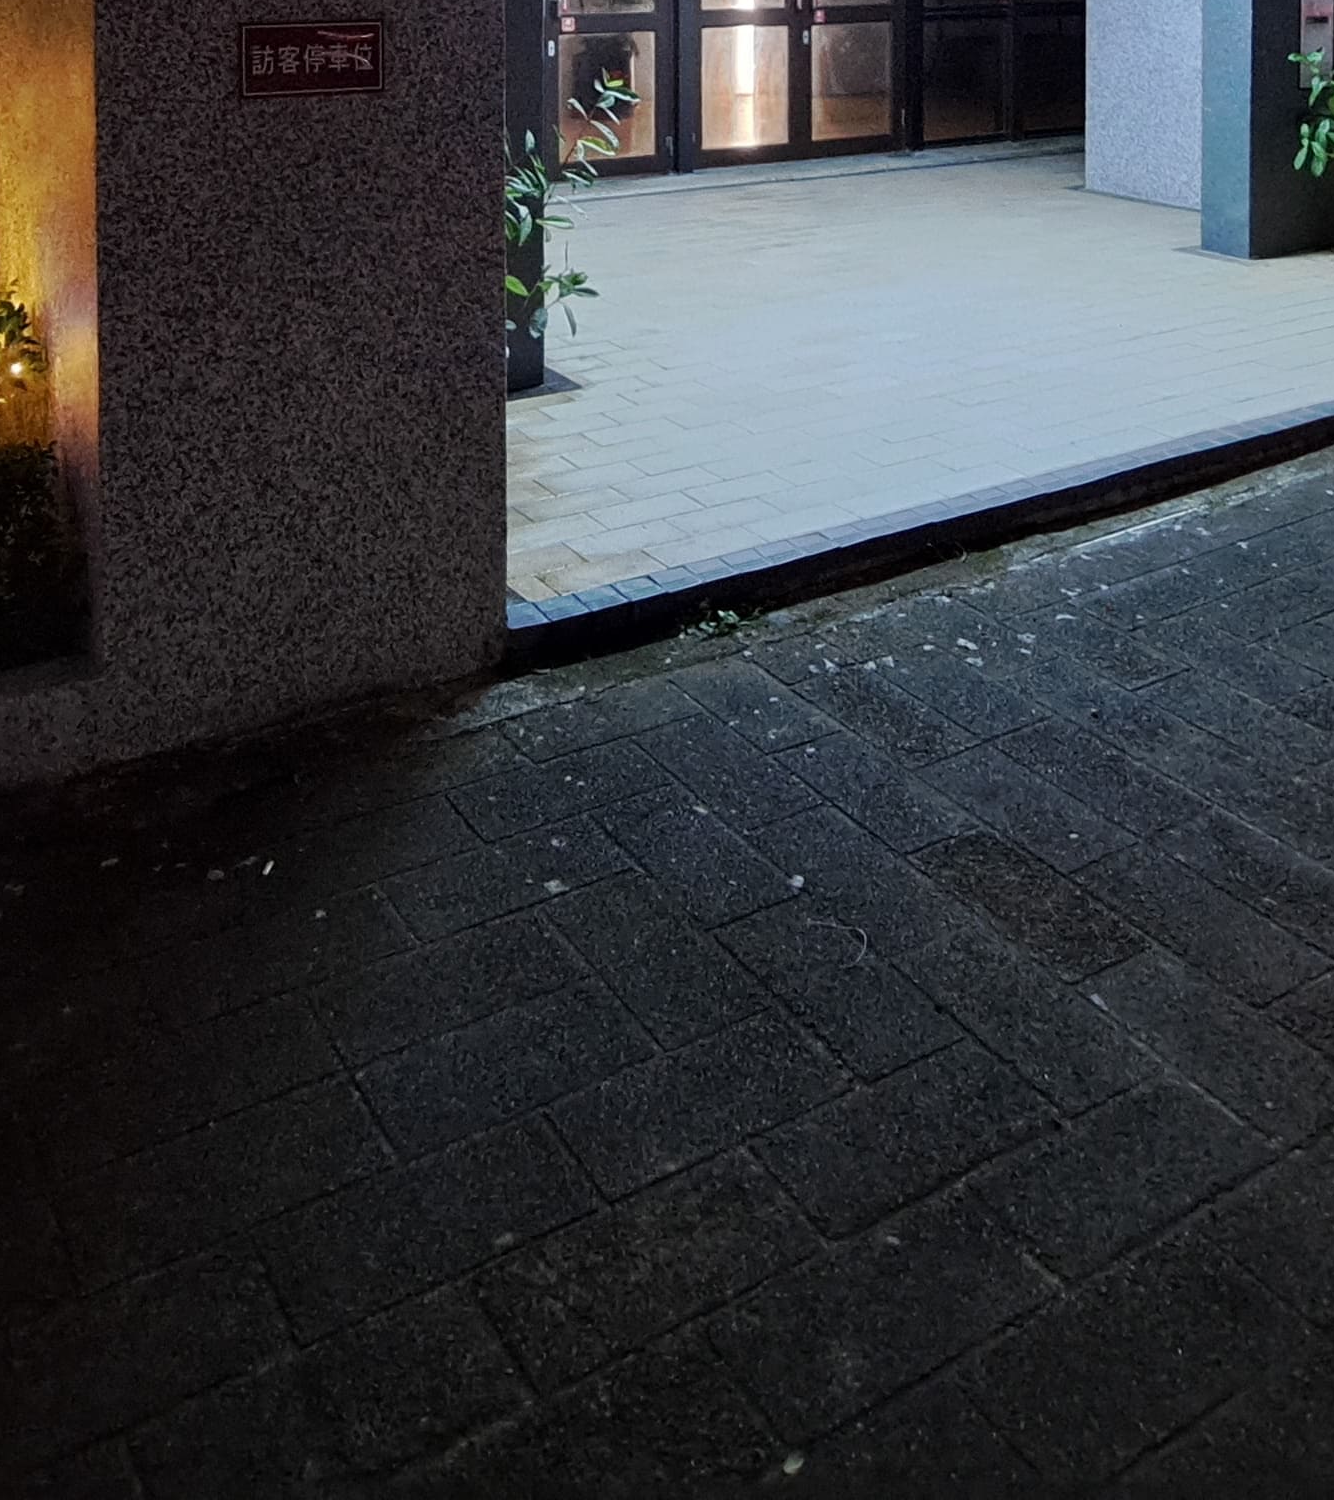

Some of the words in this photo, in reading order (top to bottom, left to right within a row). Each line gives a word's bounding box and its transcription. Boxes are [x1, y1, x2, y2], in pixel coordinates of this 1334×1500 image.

[251, 42, 374, 75] 訪客停車位
